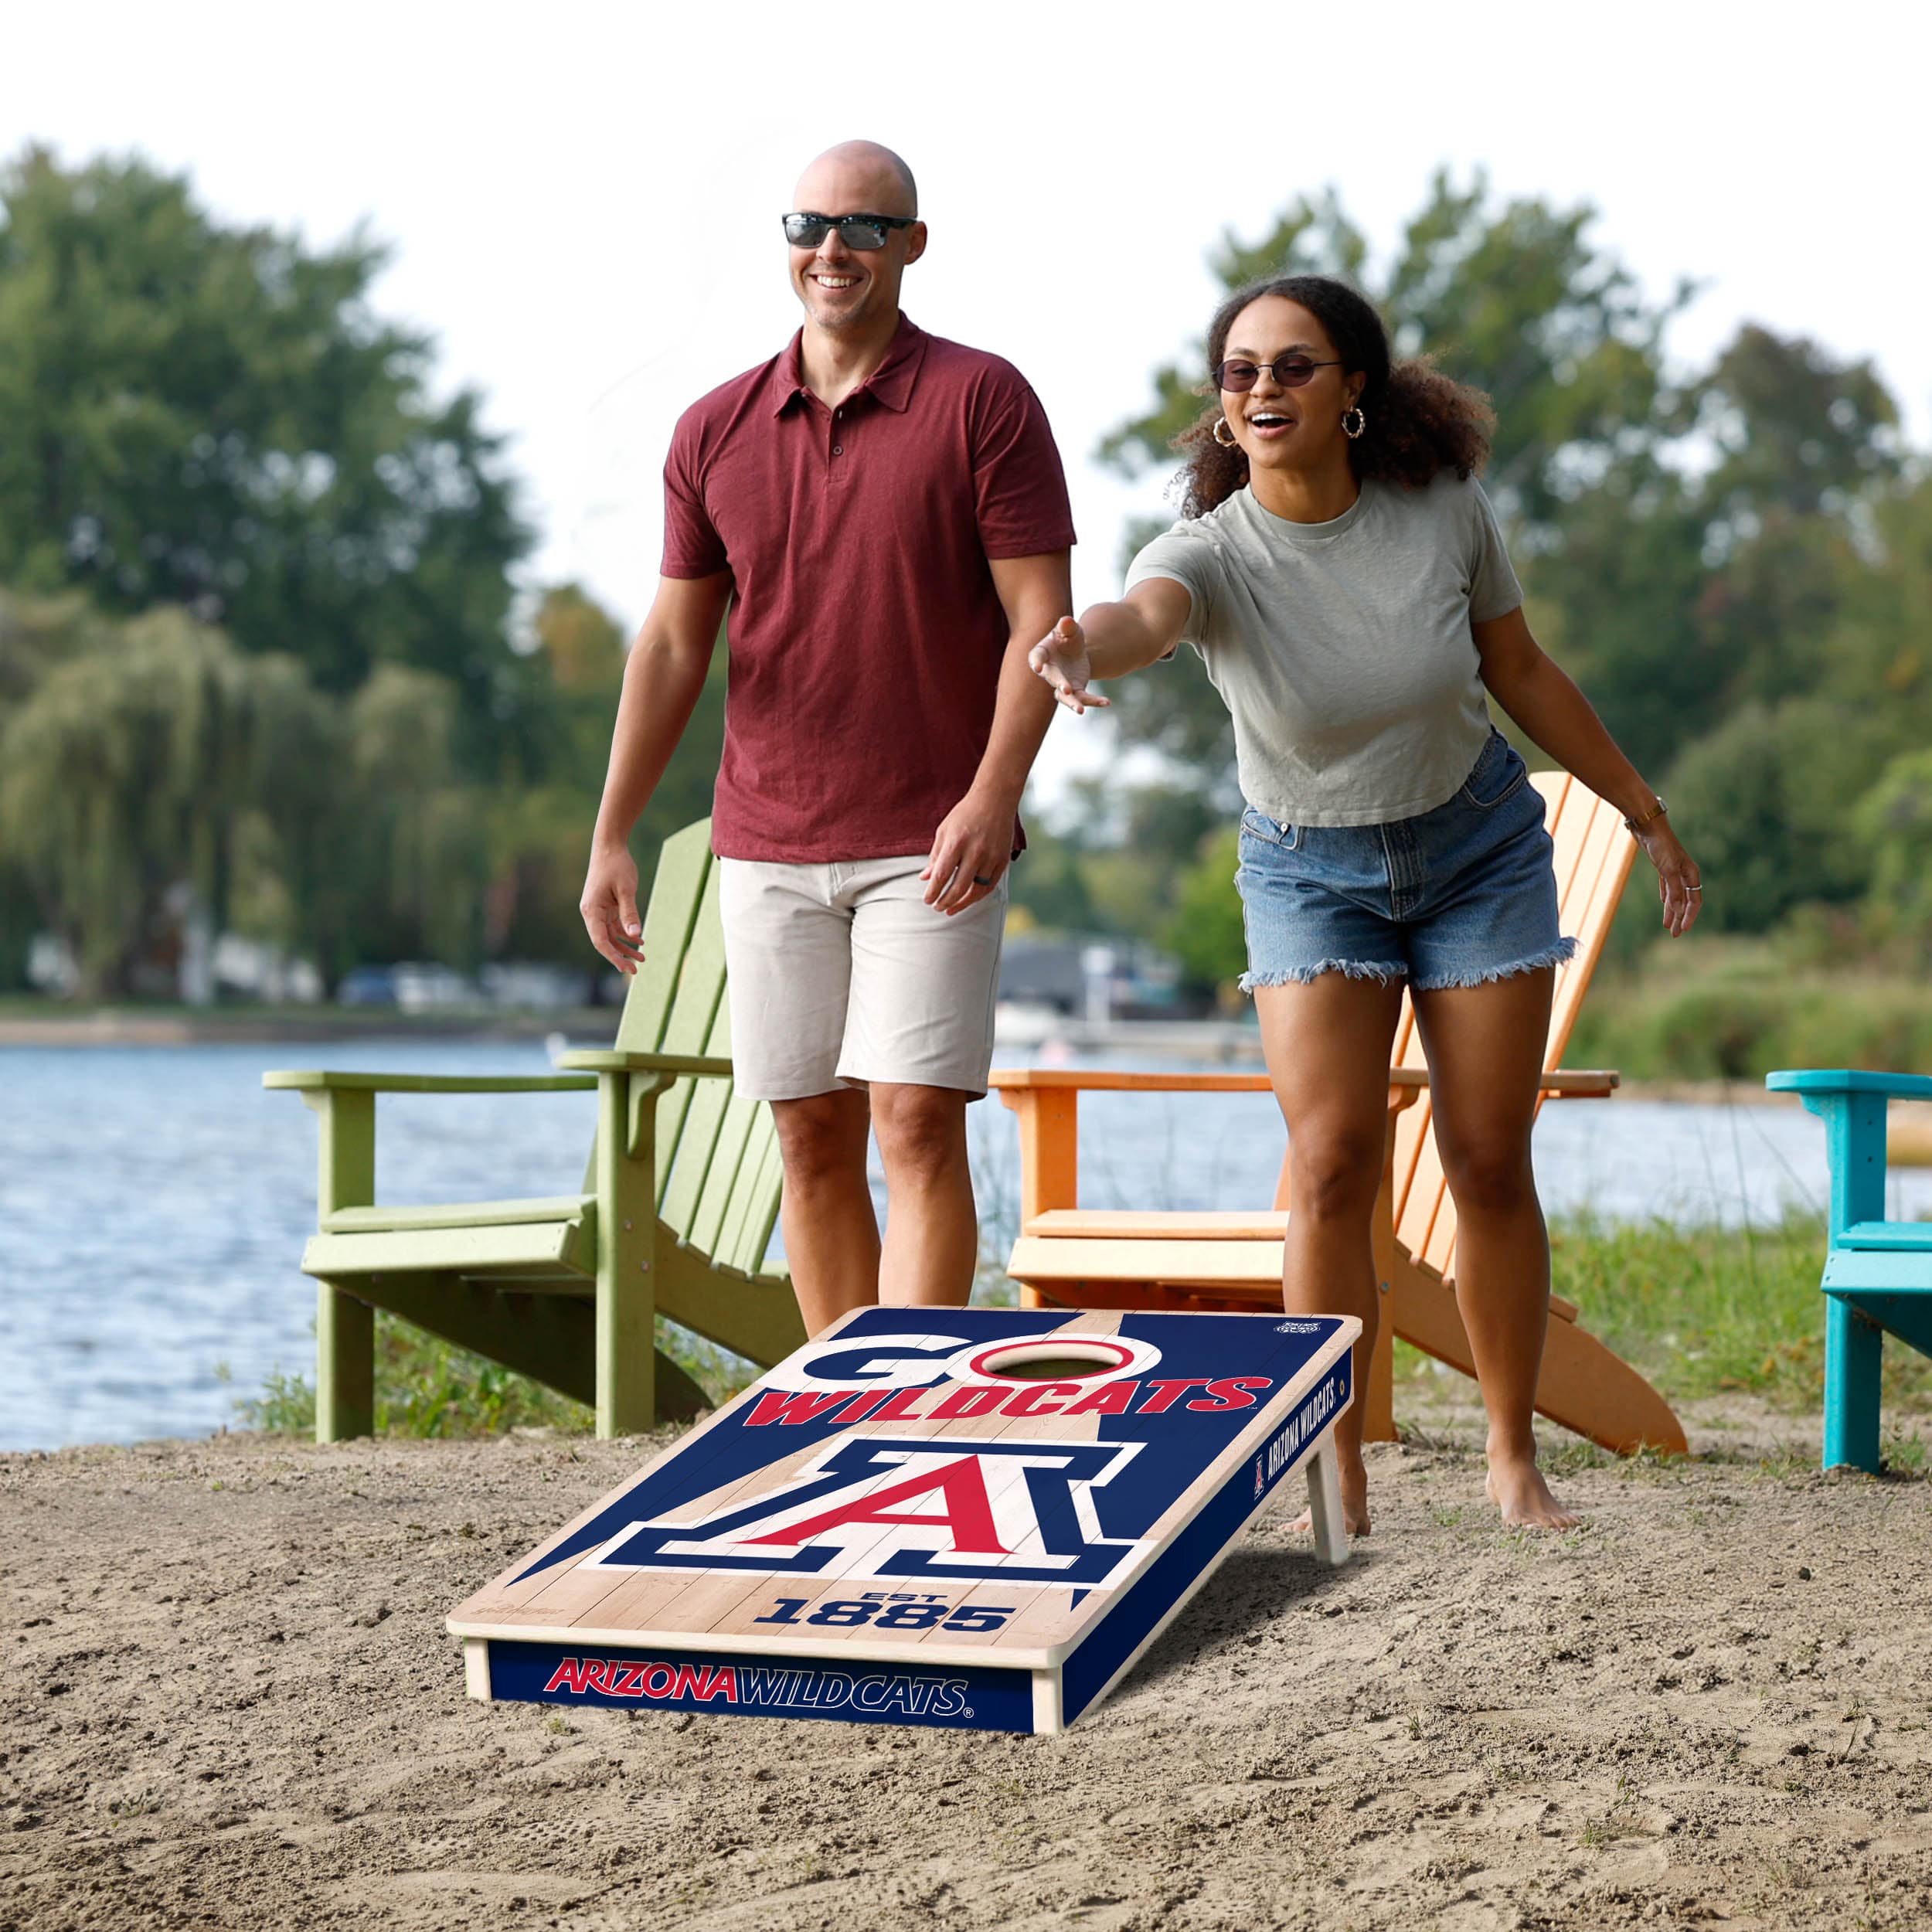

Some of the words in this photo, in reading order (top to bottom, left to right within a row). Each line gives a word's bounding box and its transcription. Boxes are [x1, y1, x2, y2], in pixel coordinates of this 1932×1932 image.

[757, 1333, 1162, 1392] GO
[1267, 1417, 1300, 1481] ARIZONA
[753, 1597, 1017, 1633] 1885
[859, 1592, 949, 1603] EST
